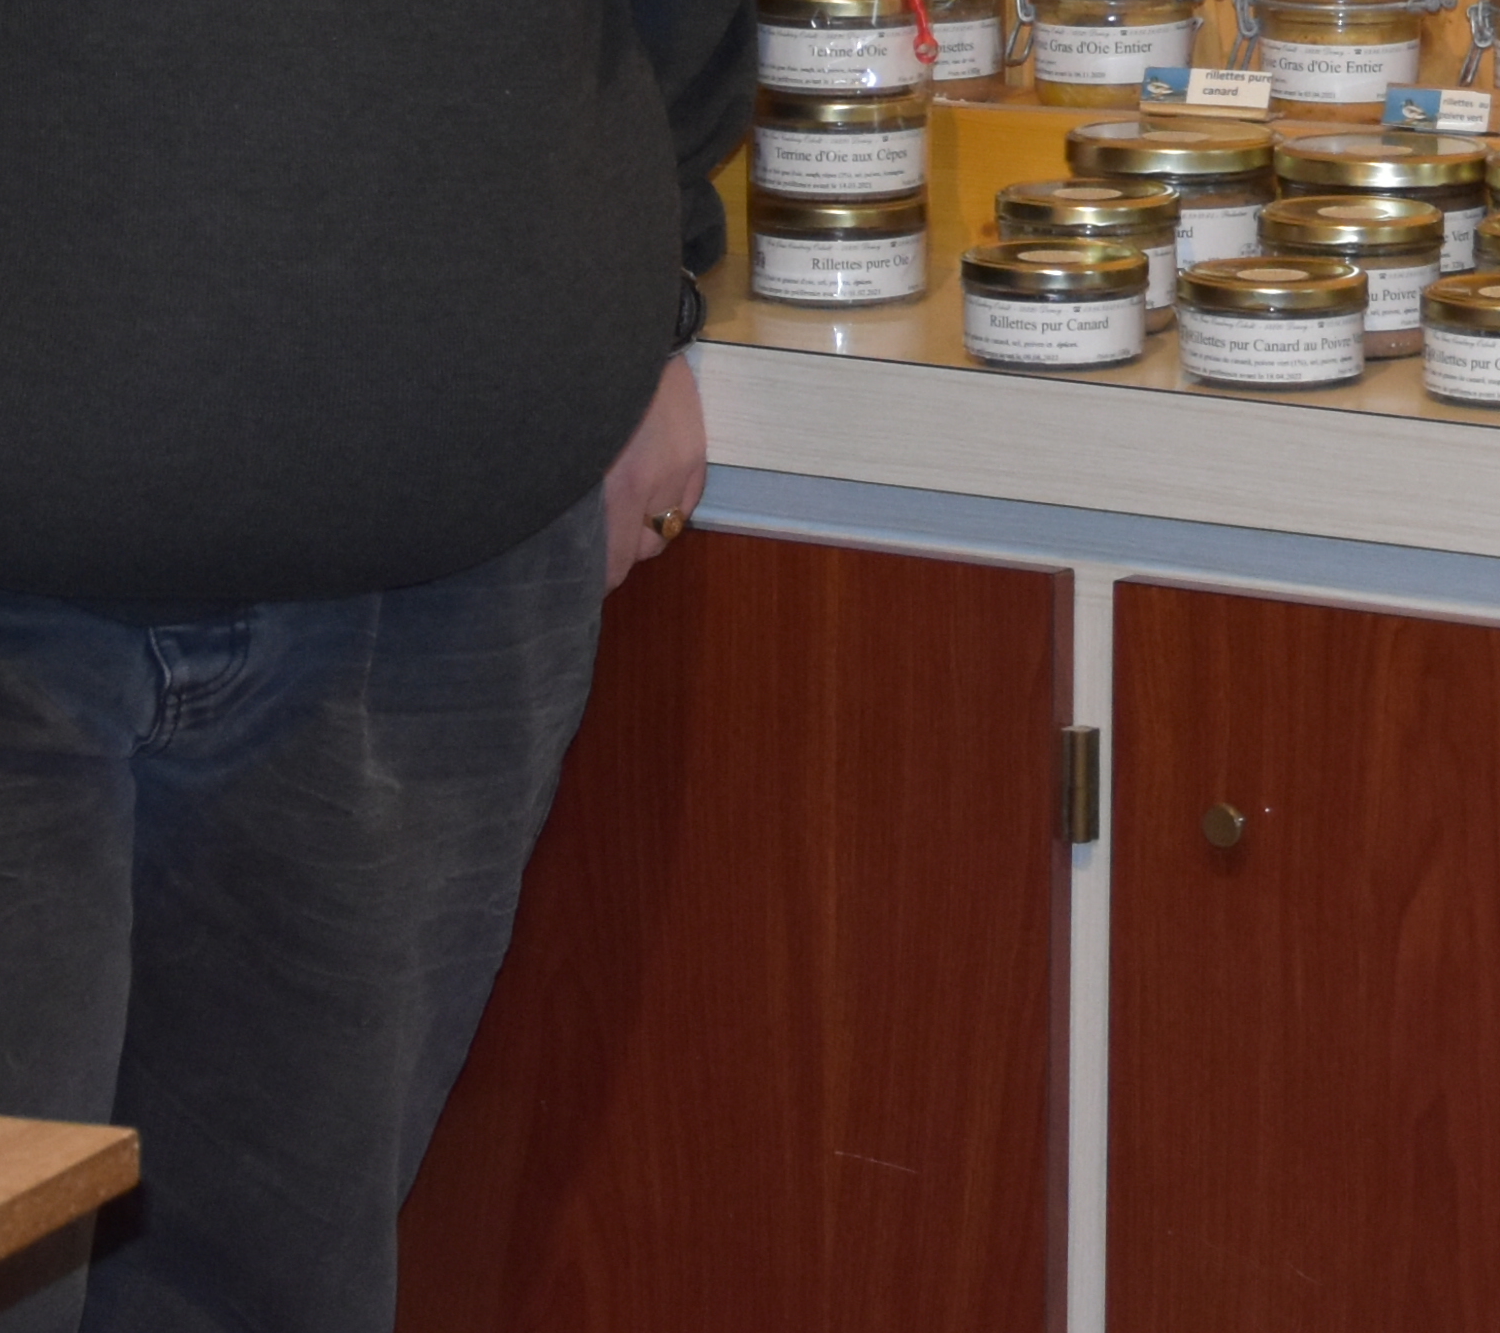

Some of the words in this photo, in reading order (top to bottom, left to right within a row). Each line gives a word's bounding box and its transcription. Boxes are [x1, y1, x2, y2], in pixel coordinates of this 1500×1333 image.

[1205, 70, 1245, 81] rillettes
[1247, 74, 1273, 84] pure
[1202, 87, 1238, 96] canard
[988, 314, 1037, 330] Rillettes
[1041, 319, 1063, 334] pur
[1066, 315, 1110, 331] Canard
